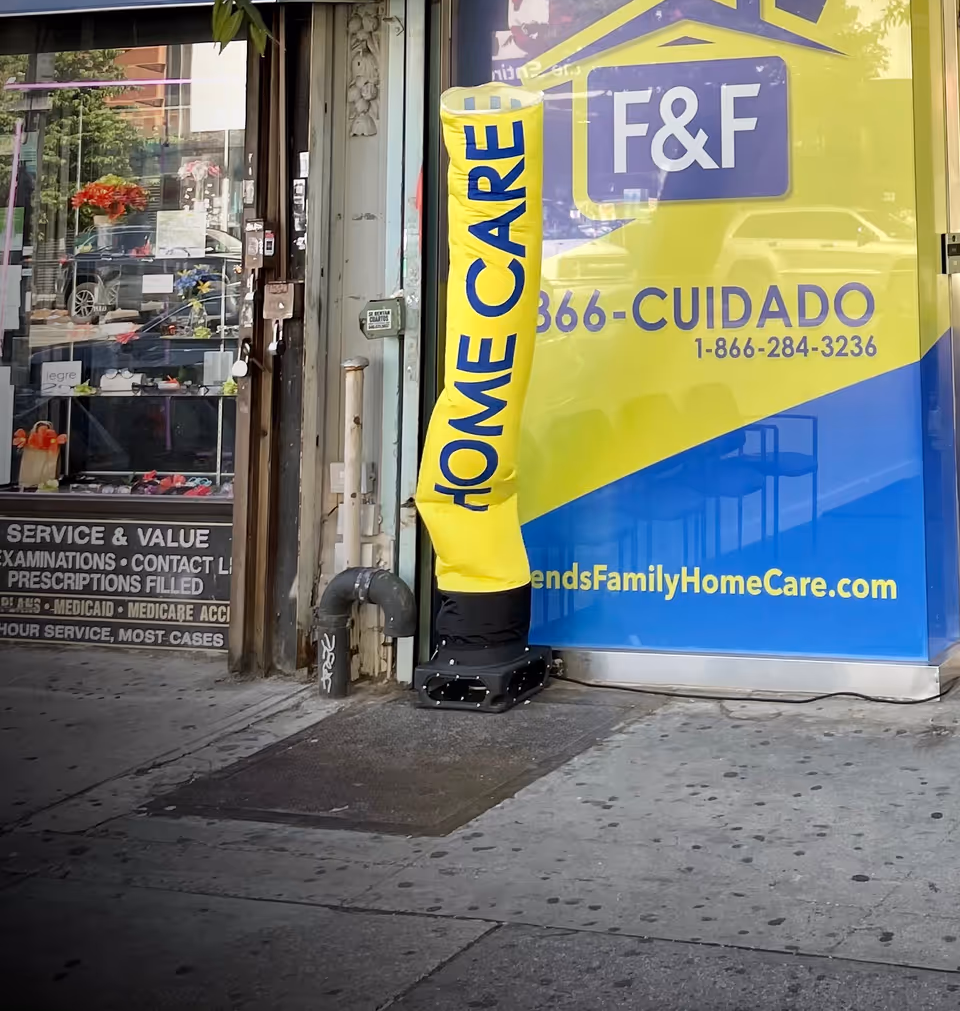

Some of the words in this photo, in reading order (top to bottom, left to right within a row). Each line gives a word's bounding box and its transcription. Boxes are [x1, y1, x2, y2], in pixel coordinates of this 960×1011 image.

[613, 83, 761, 174] F&F
[464, 120, 526, 318] CARE
[695, 335, 878, 360] 1-866-284-3236
[434, 333, 517, 511] HOME
[7, 524, 105, 545] SERVICE
[112, 527, 128, 546] &
[138, 528, 209, 548] VALUE
[0, 550, 116, 571] XAMINATIONS
[131, 554, 214, 575] CONTACT
[8, 570, 141, 593] PRESCRIPTIONS
[146, 576, 204, 595] FILLED
[54, 599, 114, 617] MEDICAID
[128, 602, 194, 621] MEDICARE
[44, 624, 114, 643] SERVICE,
[118, 628, 166, 643] MOST
[169, 633, 224, 646] CASES
